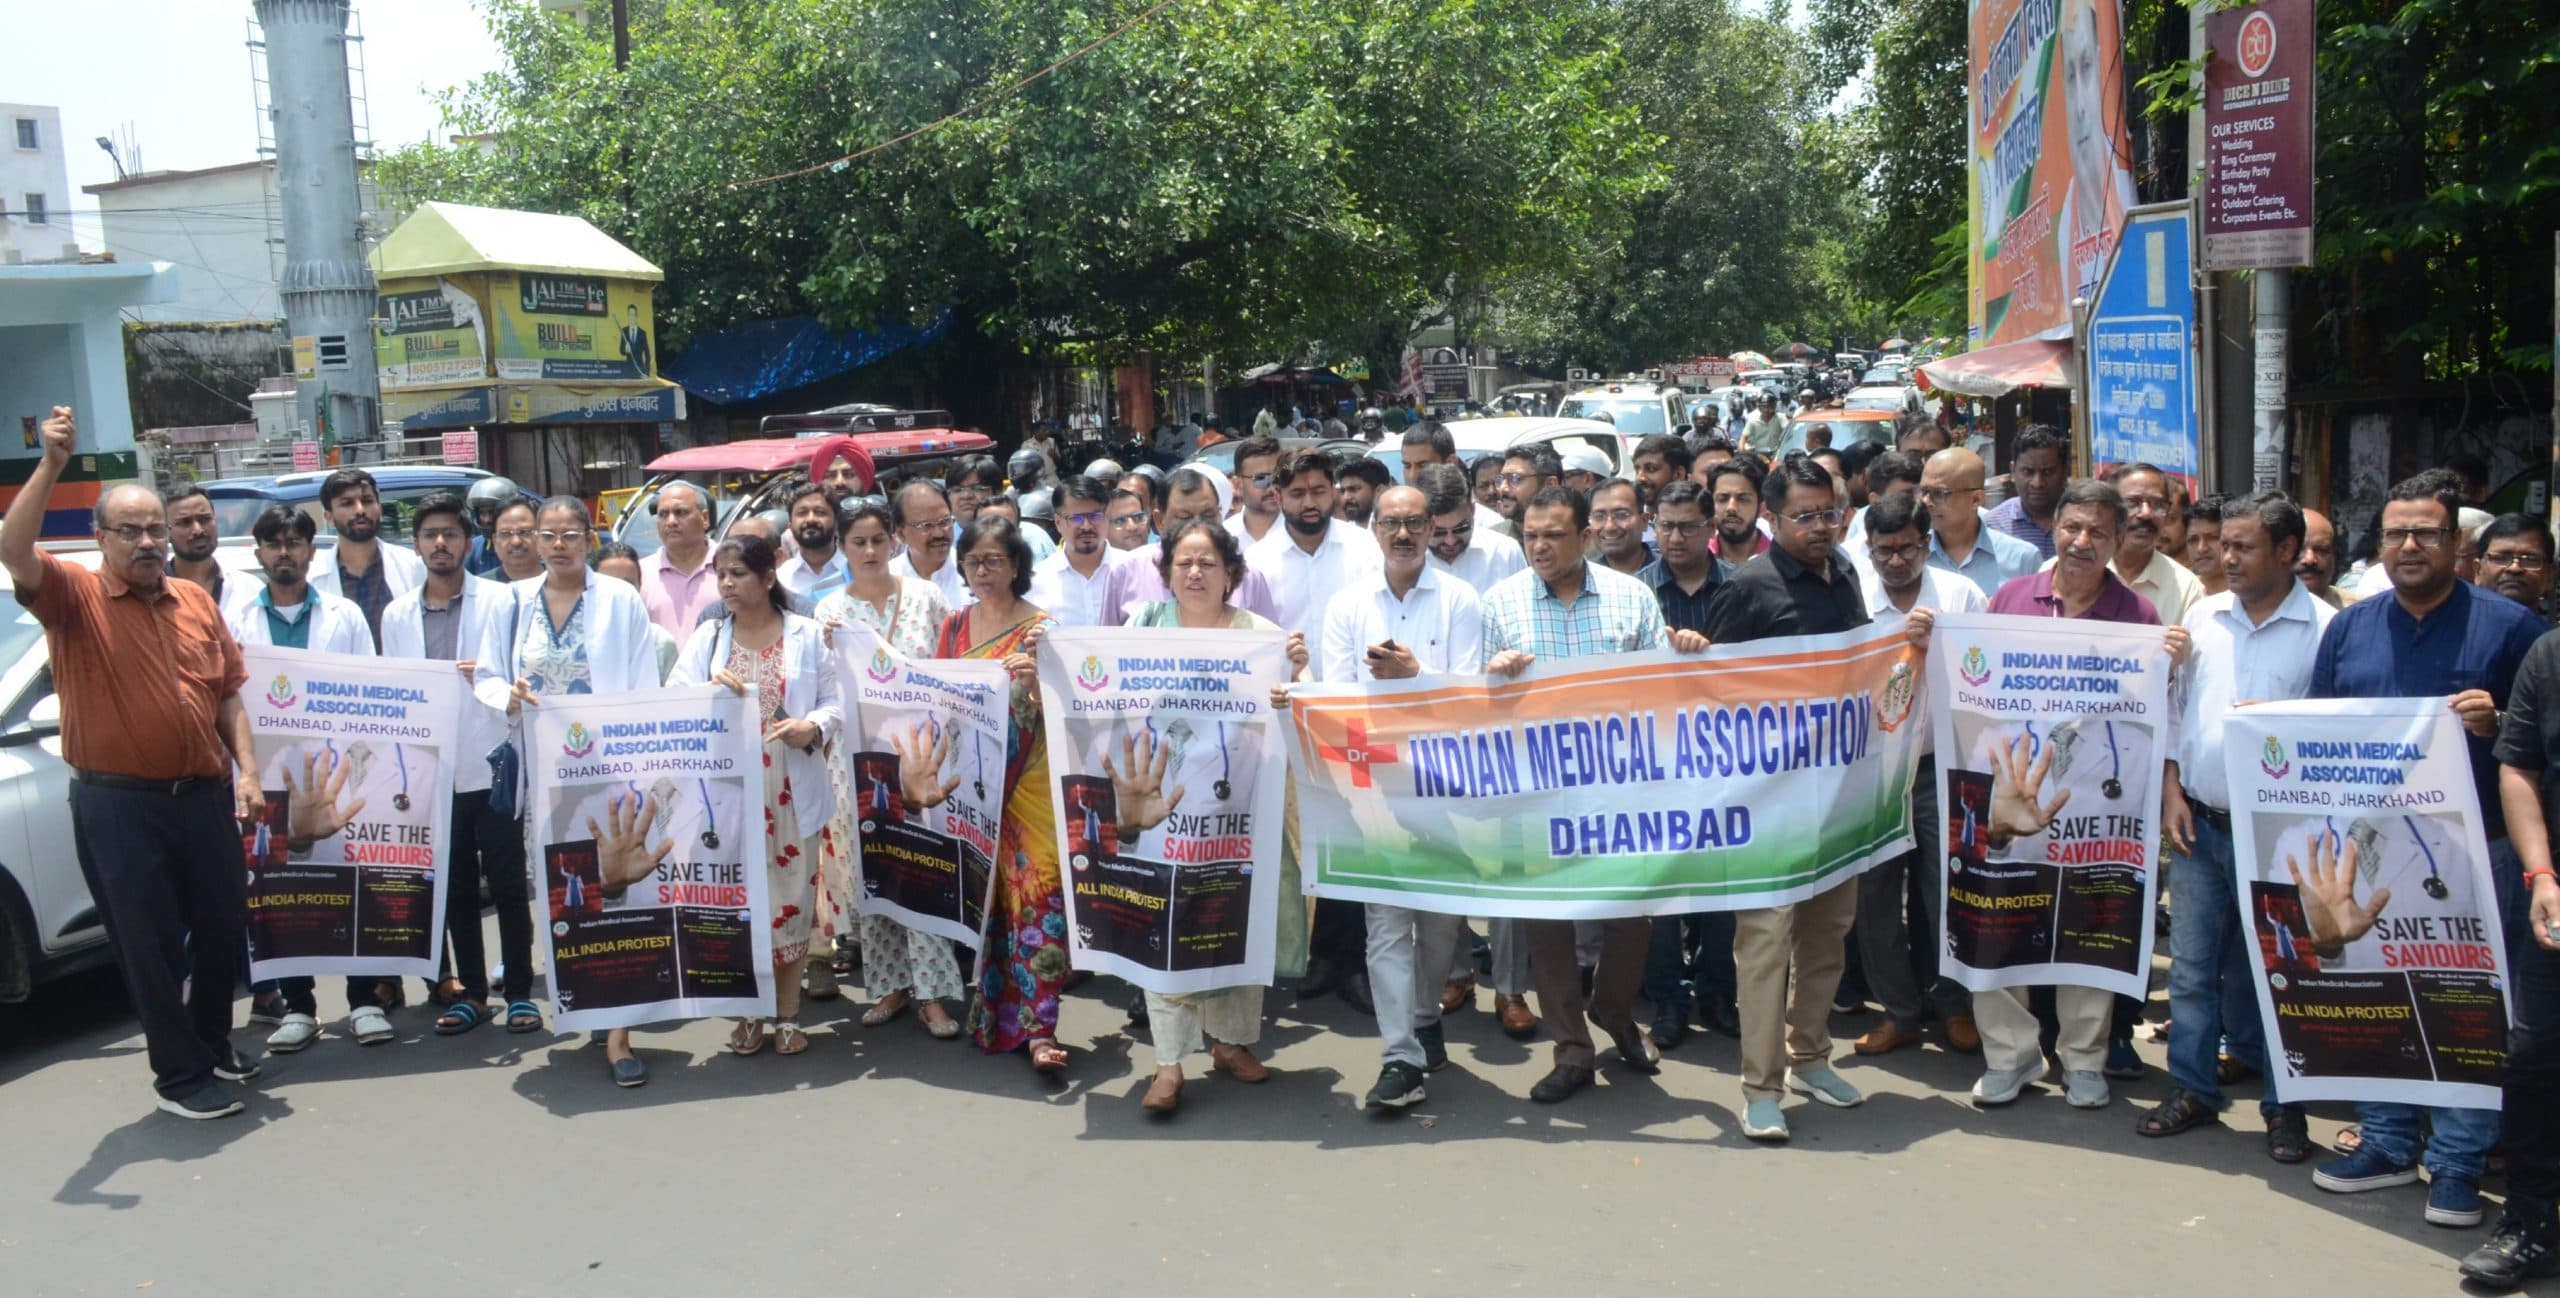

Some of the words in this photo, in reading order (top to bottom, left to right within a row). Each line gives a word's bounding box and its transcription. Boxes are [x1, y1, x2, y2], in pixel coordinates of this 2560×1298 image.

[2251, 82, 2260, 97] N
[2261, 77, 2290, 95] DINE
[2211, 123, 2231, 137] OUR
[2234, 116, 2275, 133] SERVICES
[2221, 138, 2253, 151] Wedding
[2221, 154, 2237, 167] Ring
[2238, 151, 2277, 165] Ceremony
[2221, 168, 2251, 181] Birthday
[2252, 166, 2270, 179] Party
[2221, 184, 2238, 196] Kitty
[2238, 182, 2256, 194] Party
[2221, 198, 2251, 209] Outdoor
[2252, 194, 2285, 207] Catering
[2221, 212, 2257, 225] Corporate
[2259, 210, 2283, 220] Events
[2284, 207, 2297, 219] Etc.
[523, 279, 556, 309] JAI
[383, 297, 418, 333] JAI
[537, 323, 577, 341] BUILD
[405, 335, 444, 351] BUILD
[620, 396, 659, 412] धनबाद
[1118, 657, 1176, 672] INDIAN
[1178, 657, 1252, 675] MEDICAL
[2002, 652, 2062, 670] INDIAN
[2066, 655, 2144, 673] MEDICAL
[305, 680, 359, 698] INDIAN
[362, 683, 429, 704] MEDICAL
[1119, 676, 1229, 693] ASSOCIATION
[2001, 674, 2118, 694] ASSOCIATION
[304, 700, 407, 719] ASSOCIATION
[864, 687, 937, 706] DHANBAD,
[938, 697, 1000, 732] JHARKHAND
[1072, 697, 1155, 712] DHANBAD,
[1159, 697, 1257, 715] JHARKHAND
[1958, 691, 2037, 713] DHANBAD,
[2042, 699, 2146, 714] JHARKHAND
[258, 715, 337, 734] DHANBAD,
[341, 721, 432, 739] JHARKHAND
[602, 721, 656, 738] INDIAN
[660, 719, 728, 735] MEDICAL
[603, 738, 707, 757] ASSOCIATION
[1347, 749, 1369, 763] Dr
[1409, 727, 1520, 798] INDIAN
[1525, 714, 1665, 792] MEDICAL
[1675, 694, 1872, 780] ASSOCIATION
[2297, 741, 2352, 759] INDIAN
[2356, 742, 2427, 760] MEDICAL
[558, 761, 638, 779] DHANBAD,
[642, 758, 733, 773] JHARKHAND
[2300, 765, 2404, 785] ASSOCIATION
[2257, 789, 2335, 807] DHANBAD,
[2339, 789, 2446, 809] JHARKHAND
[946, 795, 978, 826] SAVE
[979, 811, 998, 840] THE
[1167, 812, 1210, 837] SAVE
[1215, 813, 1251, 836] THE
[2049, 815, 2100, 841] SAVE
[2106, 815, 2144, 841] THE
[344, 822, 392, 843] SAVE
[398, 824, 432, 845] THE
[1550, 805, 1752, 856] DHANBAD
[344, 843, 433, 866] SAVIOURS
[863, 842, 884, 855] ALL
[885, 843, 913, 862] INDIA
[913, 851, 958, 874] PROTEST
[1163, 837, 1253, 863] SAVIOURS
[2046, 840, 2145, 866] SAVIOURS
[657, 863, 703, 882] SAVE
[708, 863, 743, 884] THE
[248, 896, 261, 909] LL
[262, 893, 296, 906] INDIA
[297, 894, 353, 906] PROTEST
[658, 885, 747, 906] SAVIOURS
[1076, 882, 1098, 896] ALL
[1100, 883, 1125, 900] INDIA
[1125, 889, 1168, 911] PROTEST
[1950, 886, 1964, 903] ALL
[1965, 891, 1994, 910] INDIA
[1995, 894, 2054, 910] PROTEST
[2375, 917, 2436, 941] SAVE
[2439, 917, 2487, 942] THE
[556, 945, 579, 960] ALL
[580, 940, 616, 956] INDIA
[616, 935, 672, 951] PROTEST
[2382, 943, 2496, 971] SAVIOURS
[2279, 1002, 2305, 1017] ALL
[2304, 1003, 2345, 1018] INDIA
[2345, 1006, 2411, 1019] PROTEST
